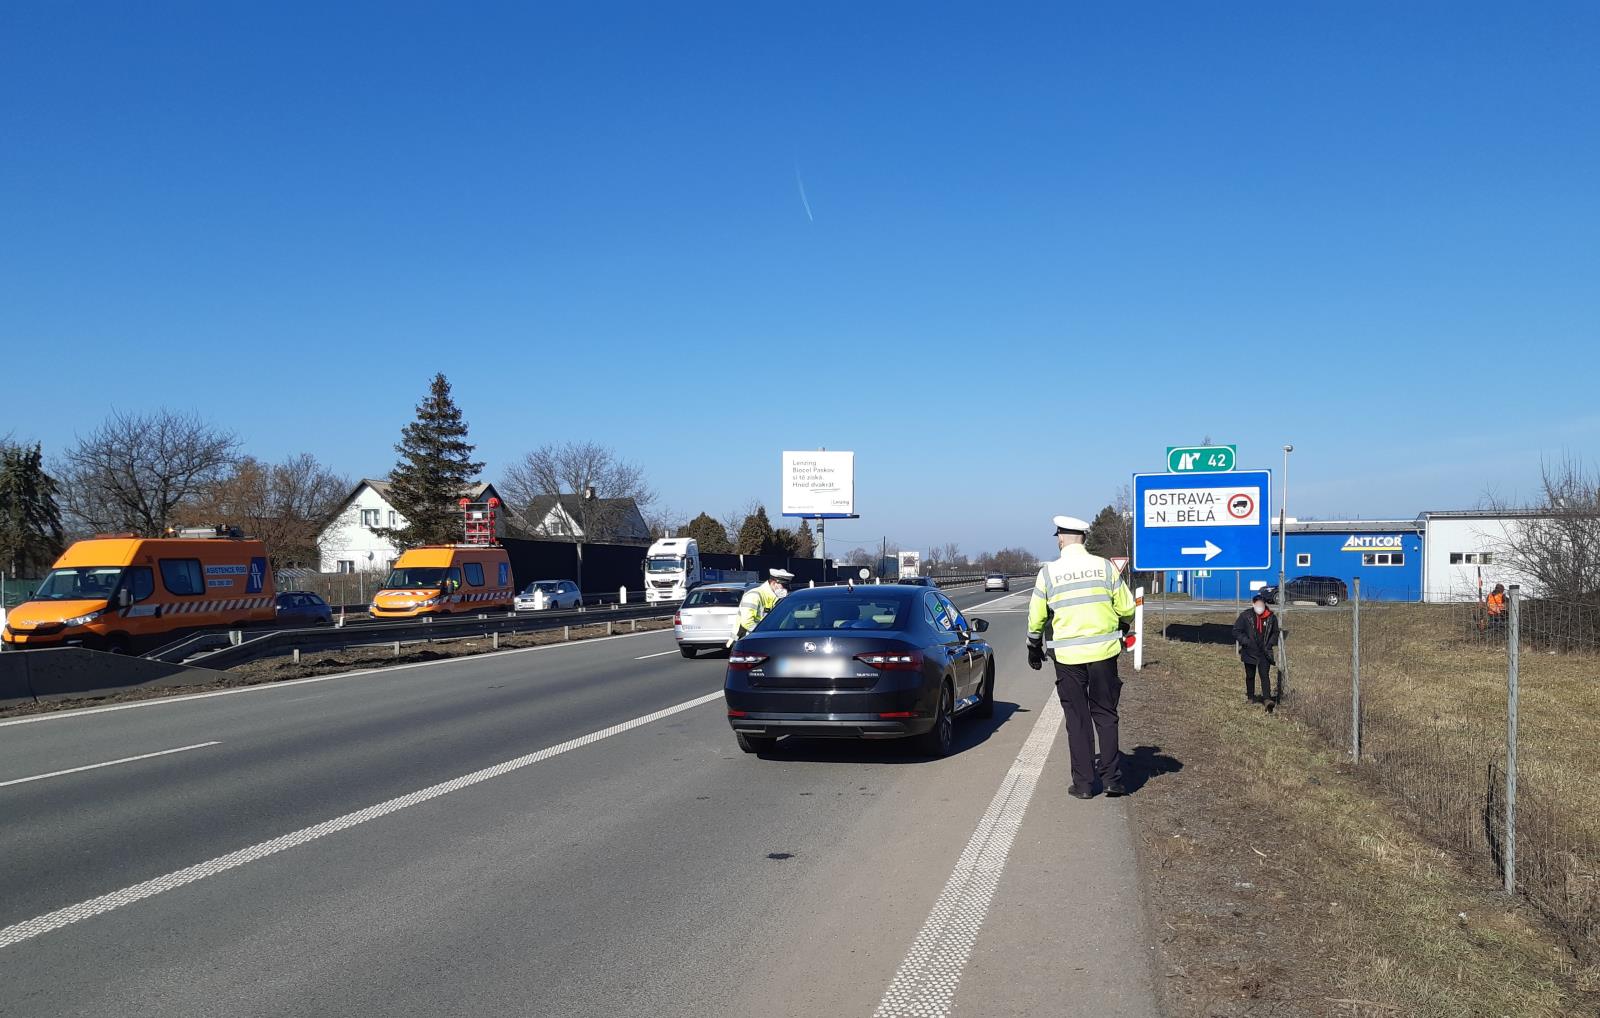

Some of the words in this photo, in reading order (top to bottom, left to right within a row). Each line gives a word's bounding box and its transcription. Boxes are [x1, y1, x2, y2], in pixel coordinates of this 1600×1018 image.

[792, 459, 817, 467] Lenzing
[1207, 454, 1226, 467] 42
[1148, 492, 1221, 506] OSTRAVA-
[1149, 510, 1170, 523] -N.
[1176, 506, 1216, 522] BĚLÁ
[1343, 535, 1403, 547] ANTICOR
[1055, 569, 1105, 584] POLICIE
